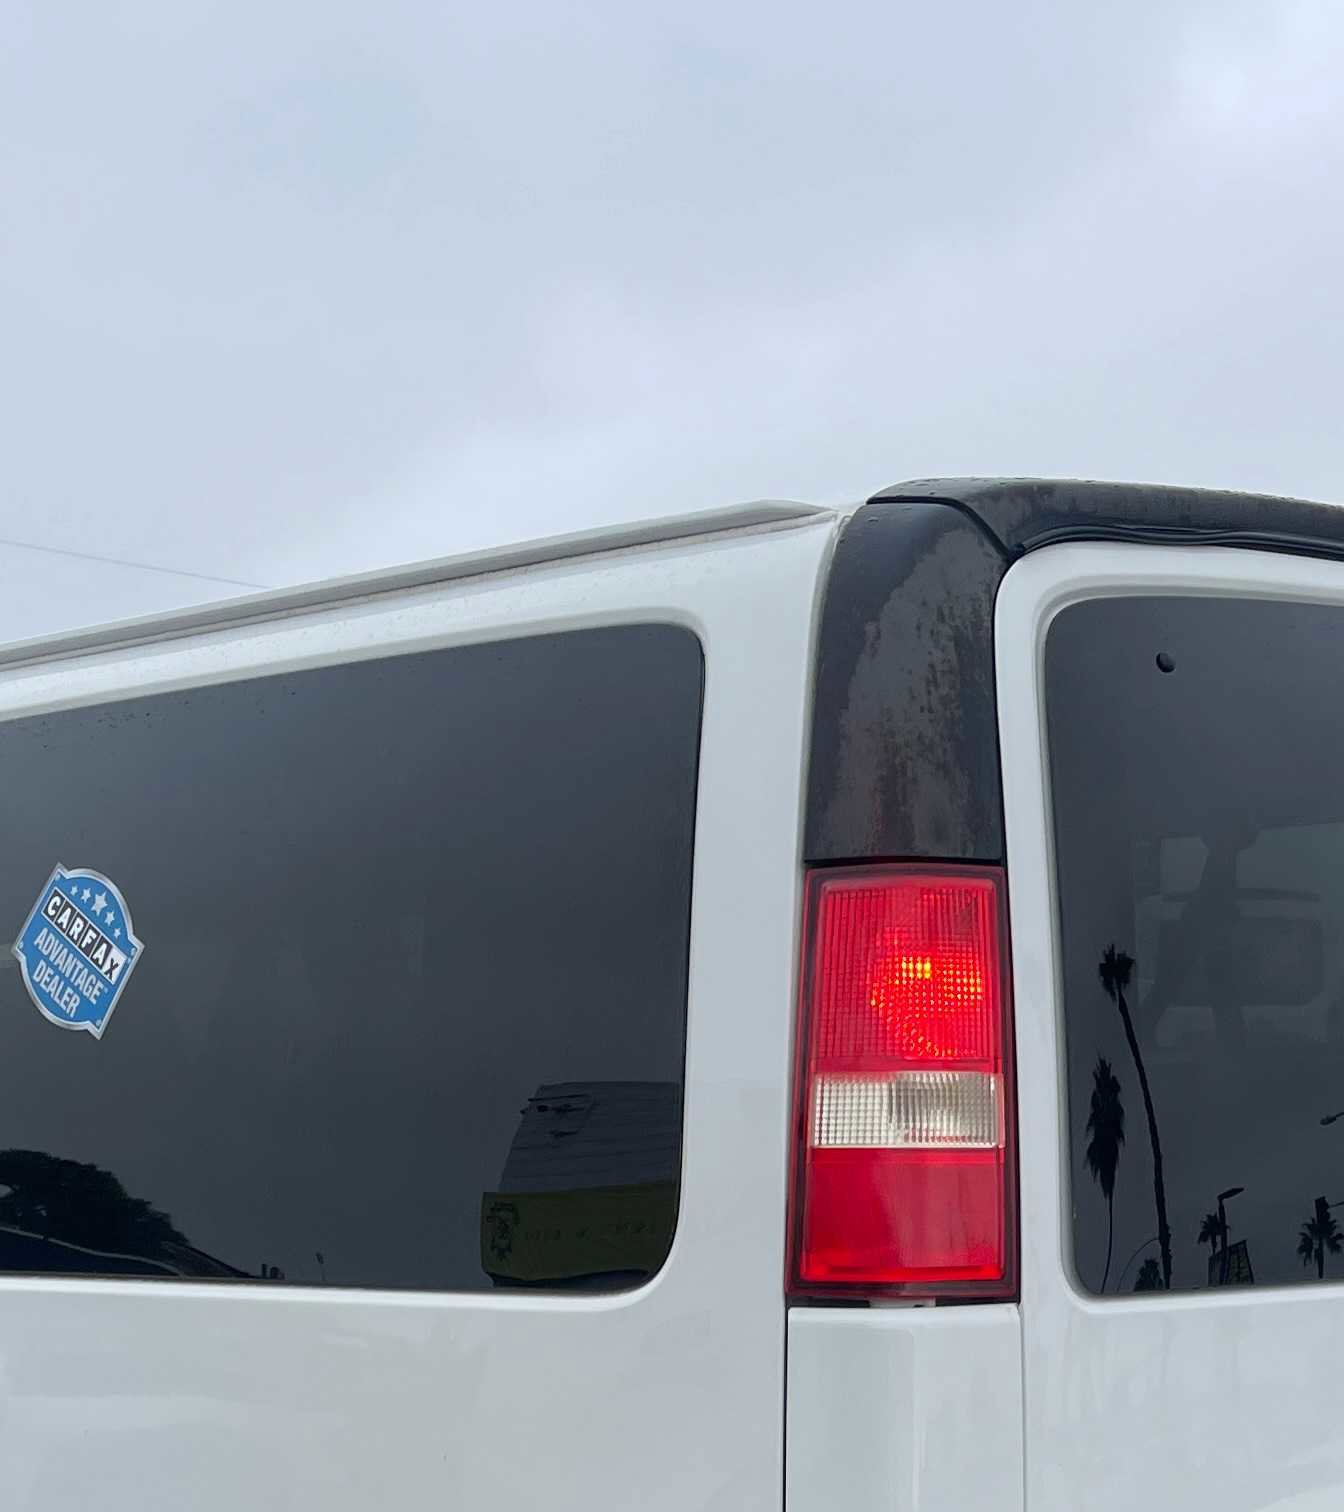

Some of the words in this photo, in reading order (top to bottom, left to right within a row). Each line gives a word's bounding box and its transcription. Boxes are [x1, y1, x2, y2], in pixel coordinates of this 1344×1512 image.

[34, 928, 105, 1004] ADVANTAGE
[47, 896, 119, 980] CARFAX
[33, 960, 81, 1017] DEALER
